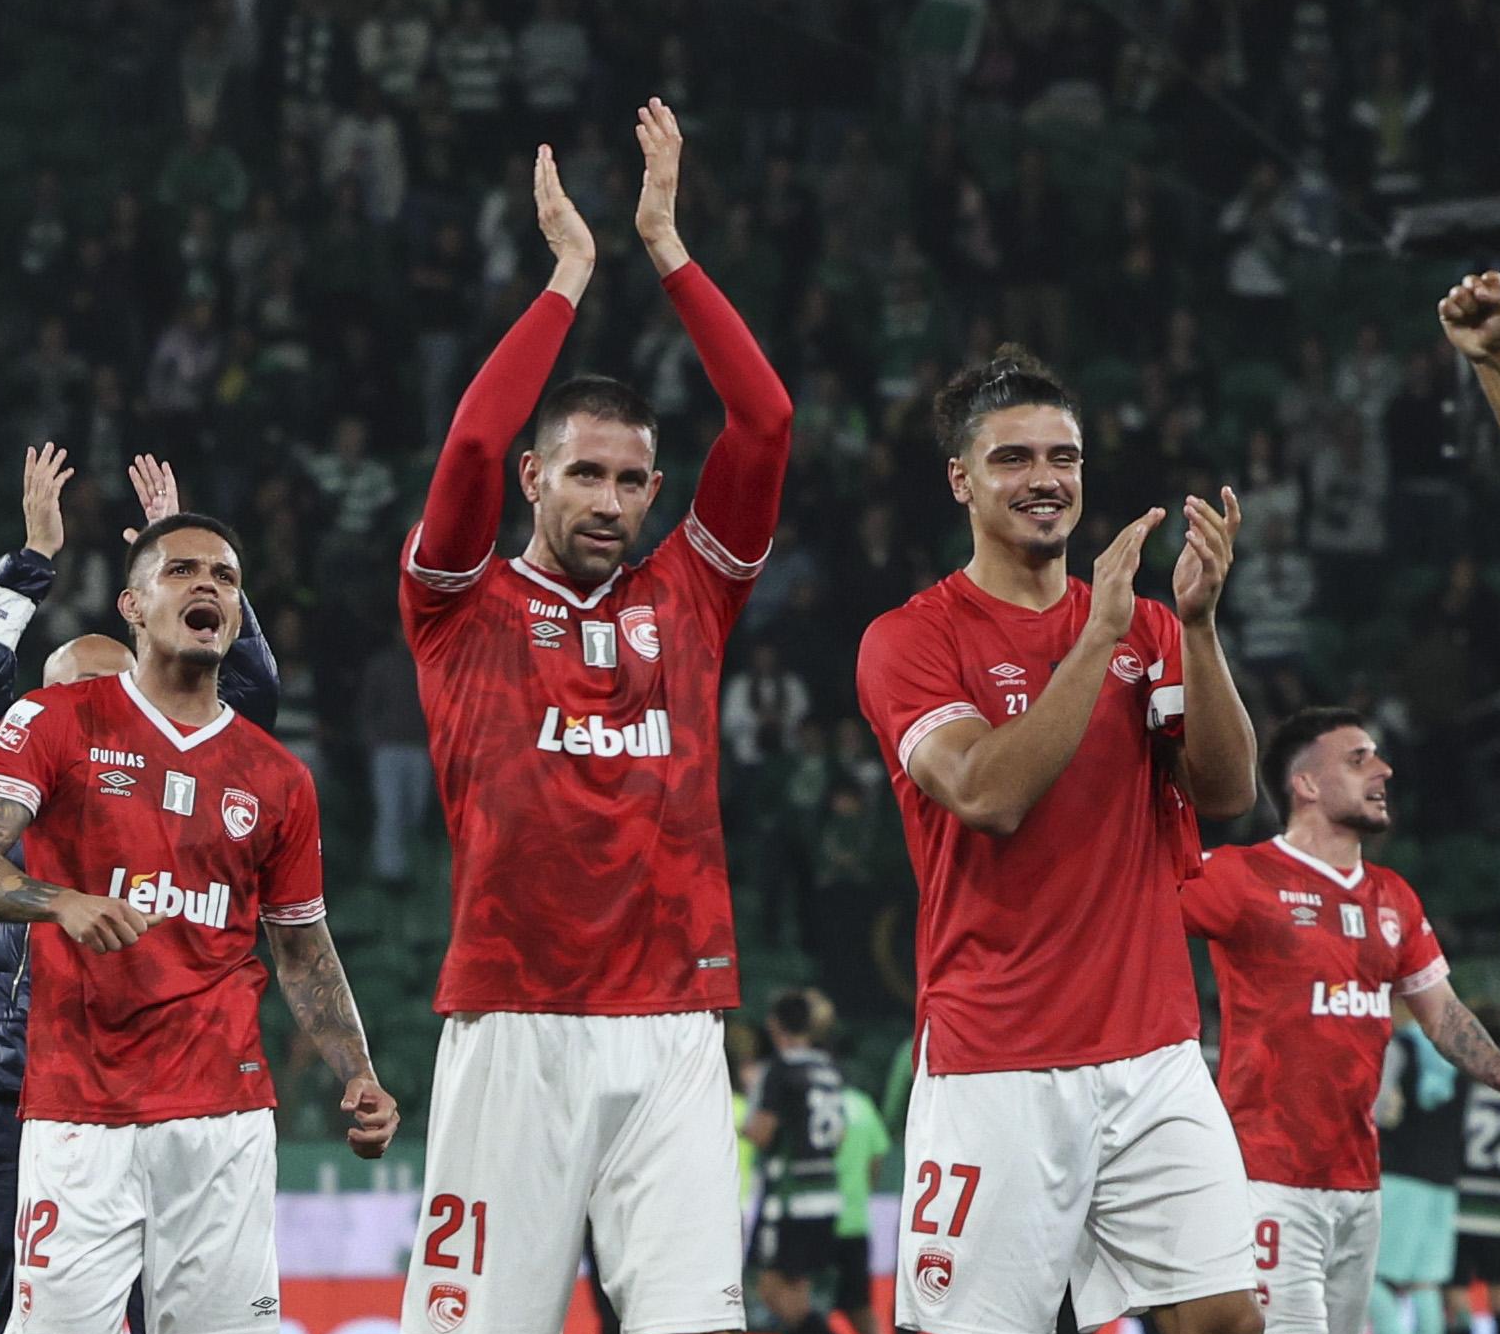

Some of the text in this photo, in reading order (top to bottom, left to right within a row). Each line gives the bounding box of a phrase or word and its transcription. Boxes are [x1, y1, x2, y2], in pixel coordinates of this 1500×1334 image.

[1005, 693, 1029, 716] 27
[99, 786, 132, 797] umbro
[17, 1197, 60, 1269] 42
[424, 1193, 488, 1276] 21
[911, 1160, 982, 1238] 27
